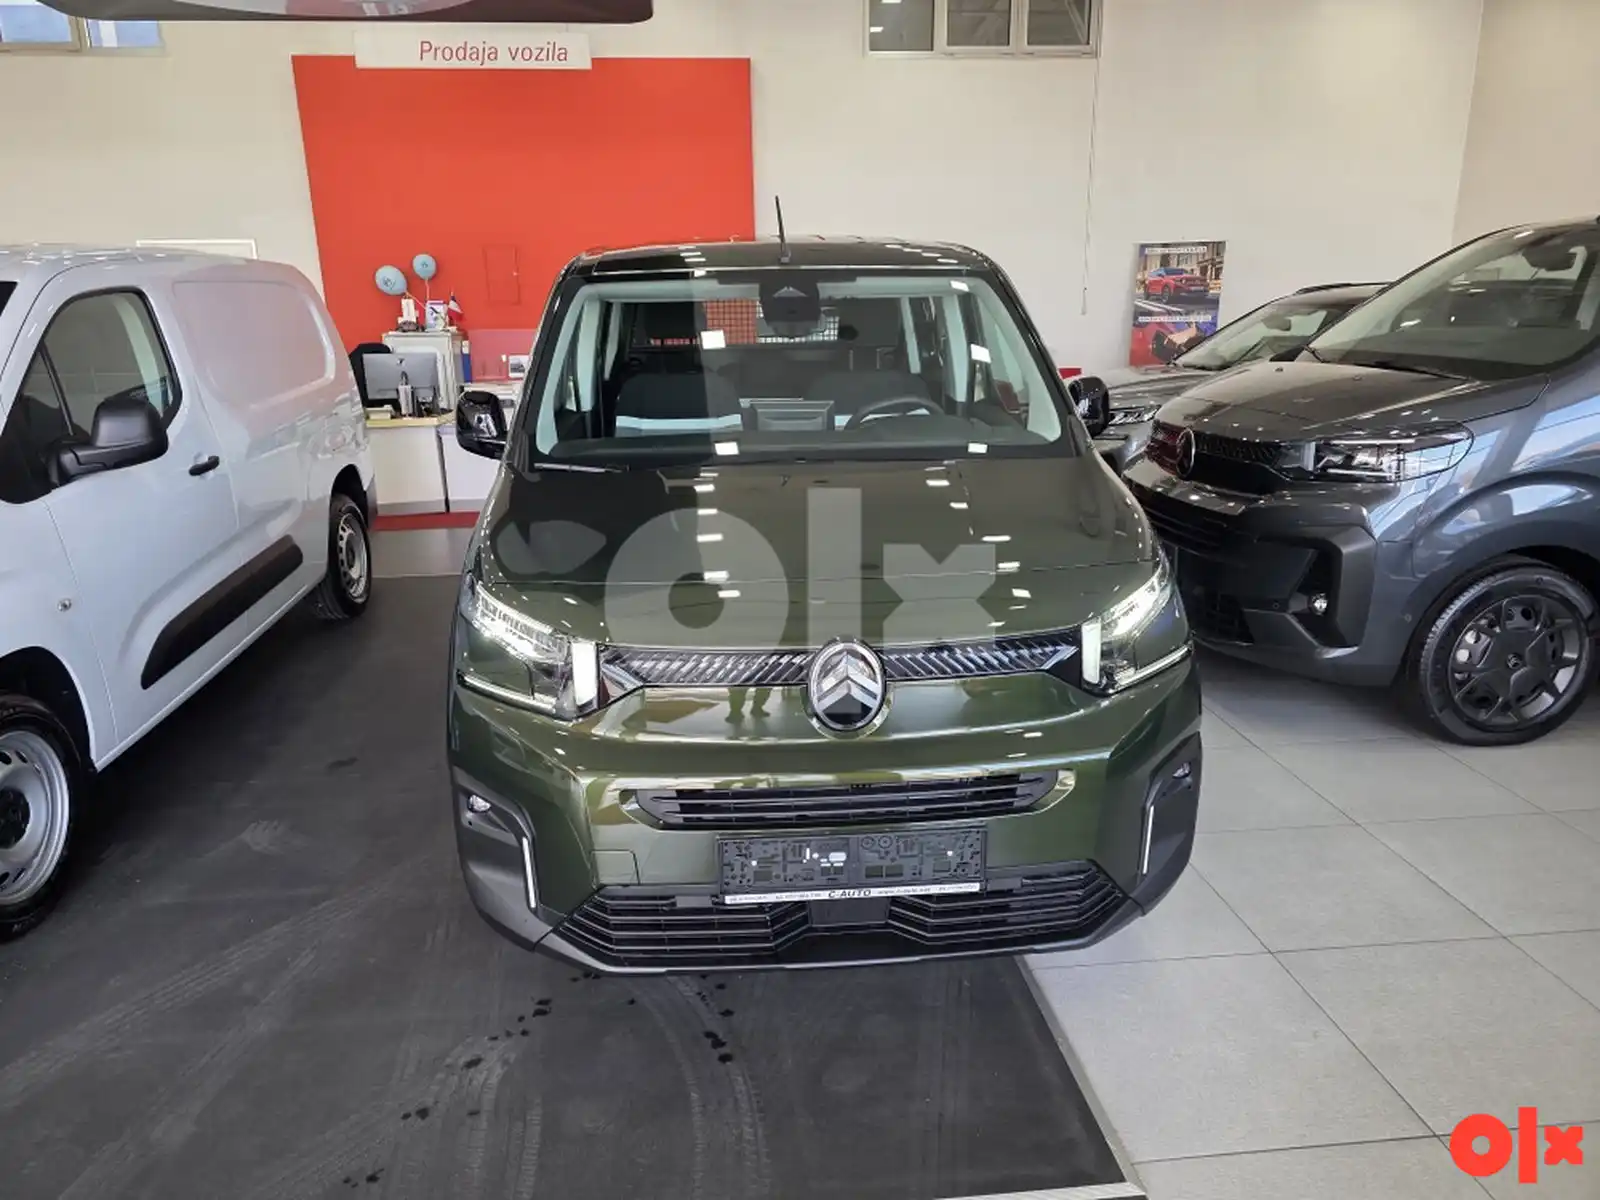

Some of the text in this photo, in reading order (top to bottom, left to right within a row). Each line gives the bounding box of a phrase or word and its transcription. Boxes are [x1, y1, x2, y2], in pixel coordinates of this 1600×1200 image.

[420, 40, 568, 66] Prodaja vozila
[828, 889, 871, 899] C-AUTO
